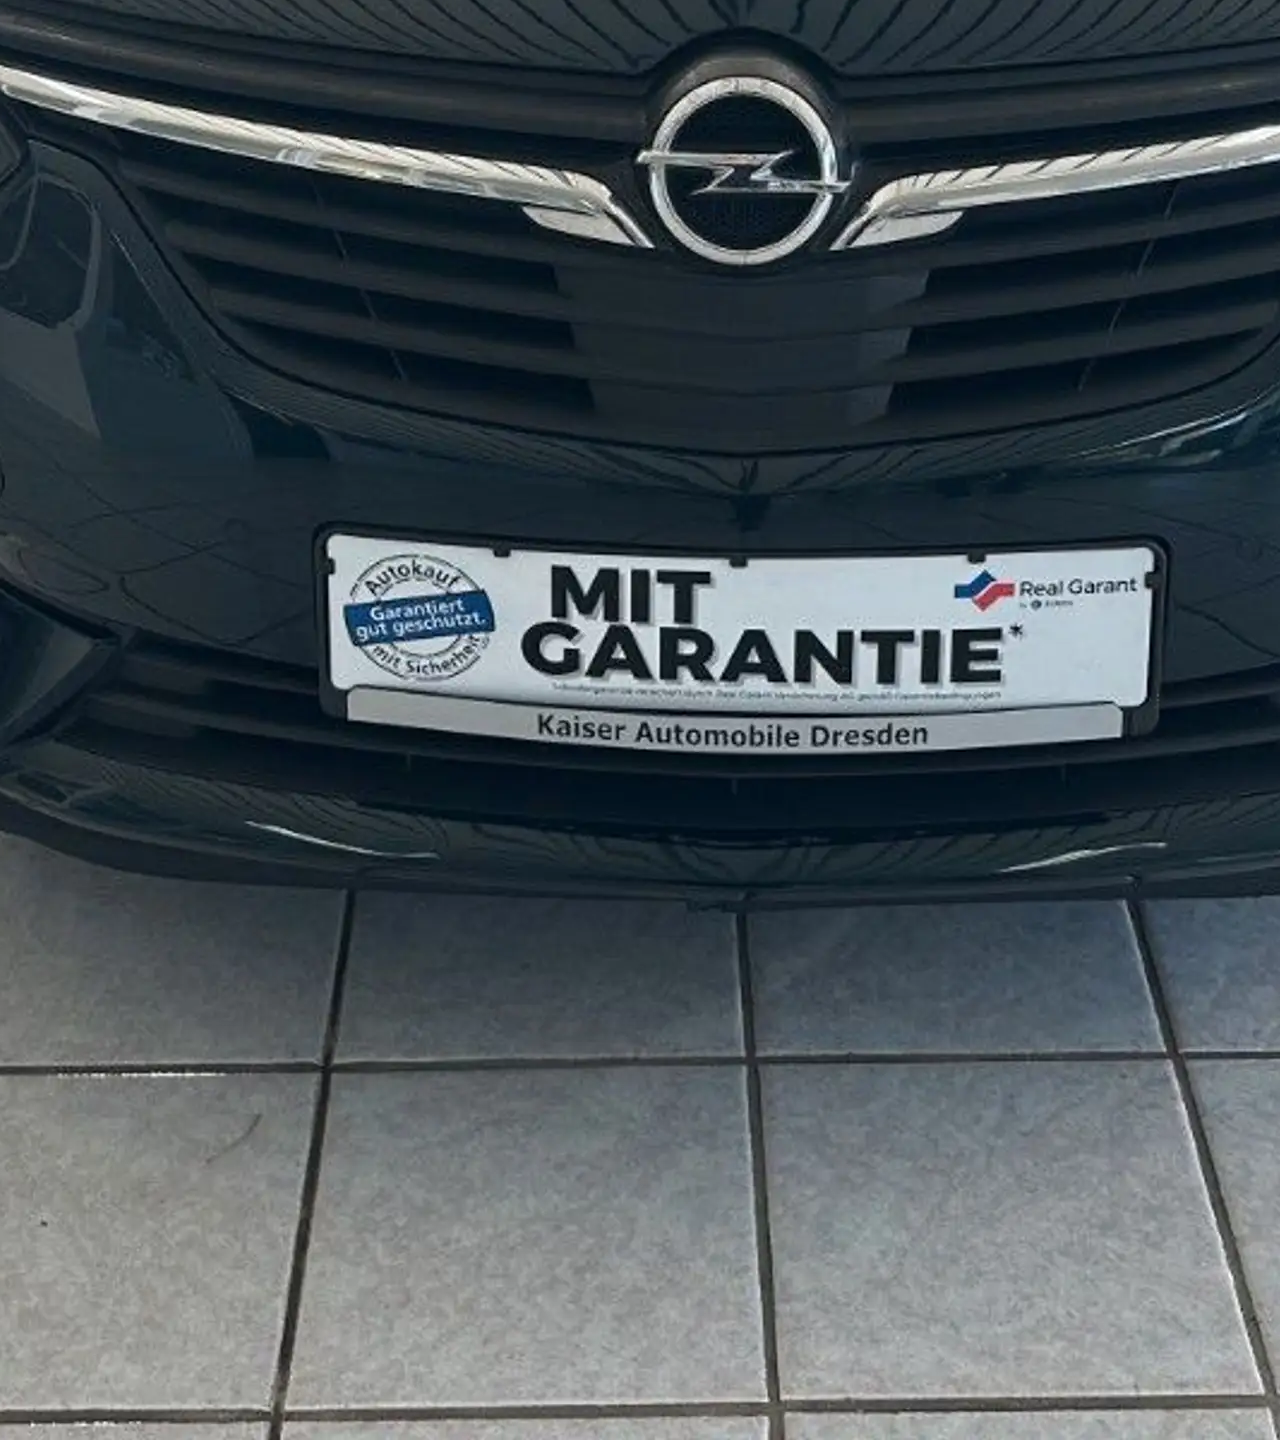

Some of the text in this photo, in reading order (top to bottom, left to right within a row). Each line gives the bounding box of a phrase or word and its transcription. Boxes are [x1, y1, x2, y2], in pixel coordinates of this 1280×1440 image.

[365, 559, 460, 596] Autokauf
[1020, 577, 1137, 597] Real Garant
[550, 564, 712, 624] MIT
[370, 598, 465, 622] Garantiert
[356, 622, 388, 642] gut
[536, 713, 929, 748] Kaiser Automobile Dresden
